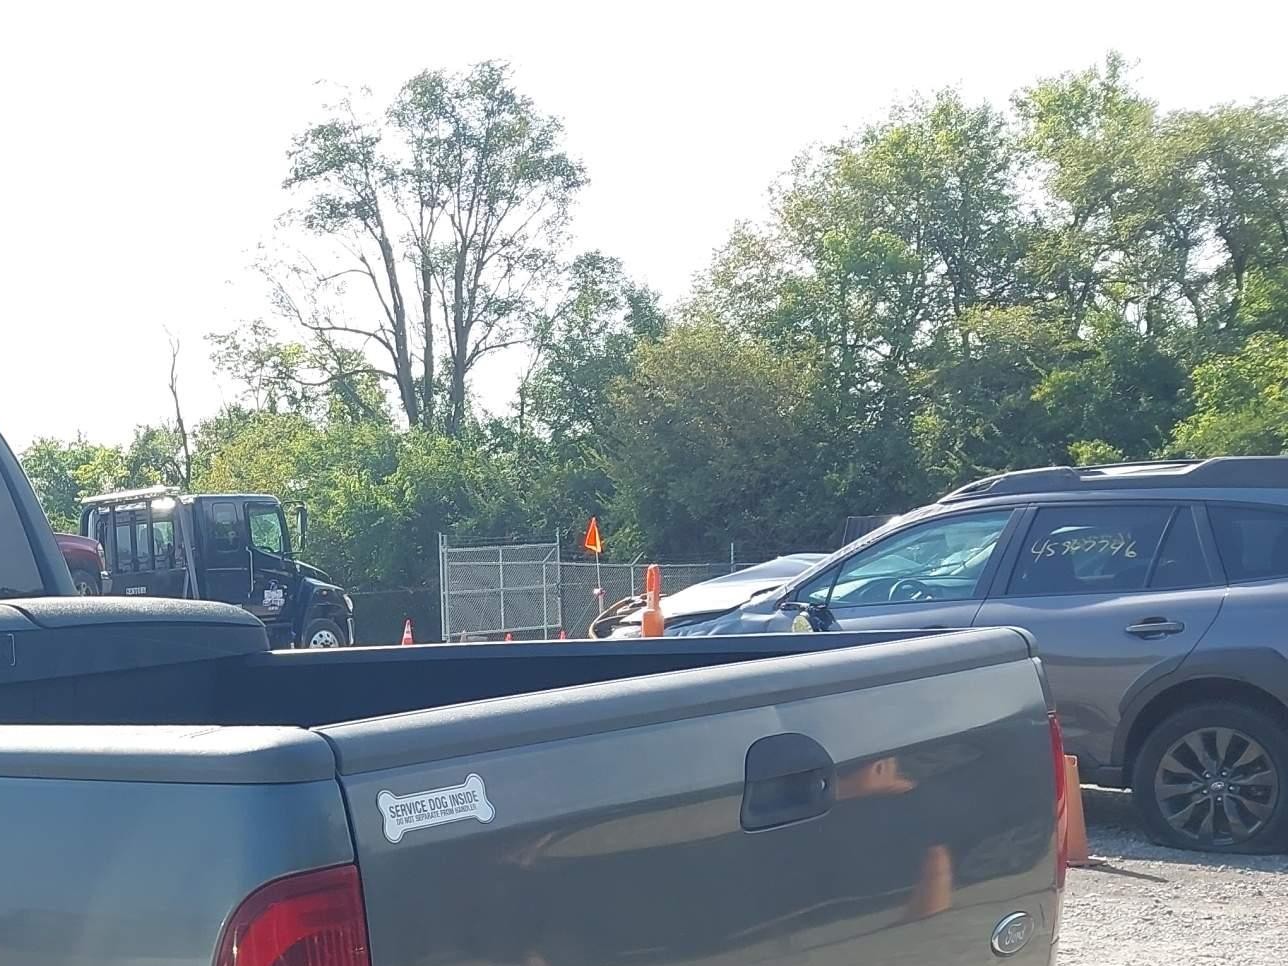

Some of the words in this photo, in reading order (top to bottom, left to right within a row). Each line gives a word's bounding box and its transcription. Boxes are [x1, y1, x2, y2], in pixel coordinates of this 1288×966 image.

[388, 800, 427, 819] SERVICE
[428, 796, 449, 811] DOG
[450, 790, 479, 809] INSIDE
[396, 817, 404, 825] DO
[415, 811, 440, 822] SEPARATE
